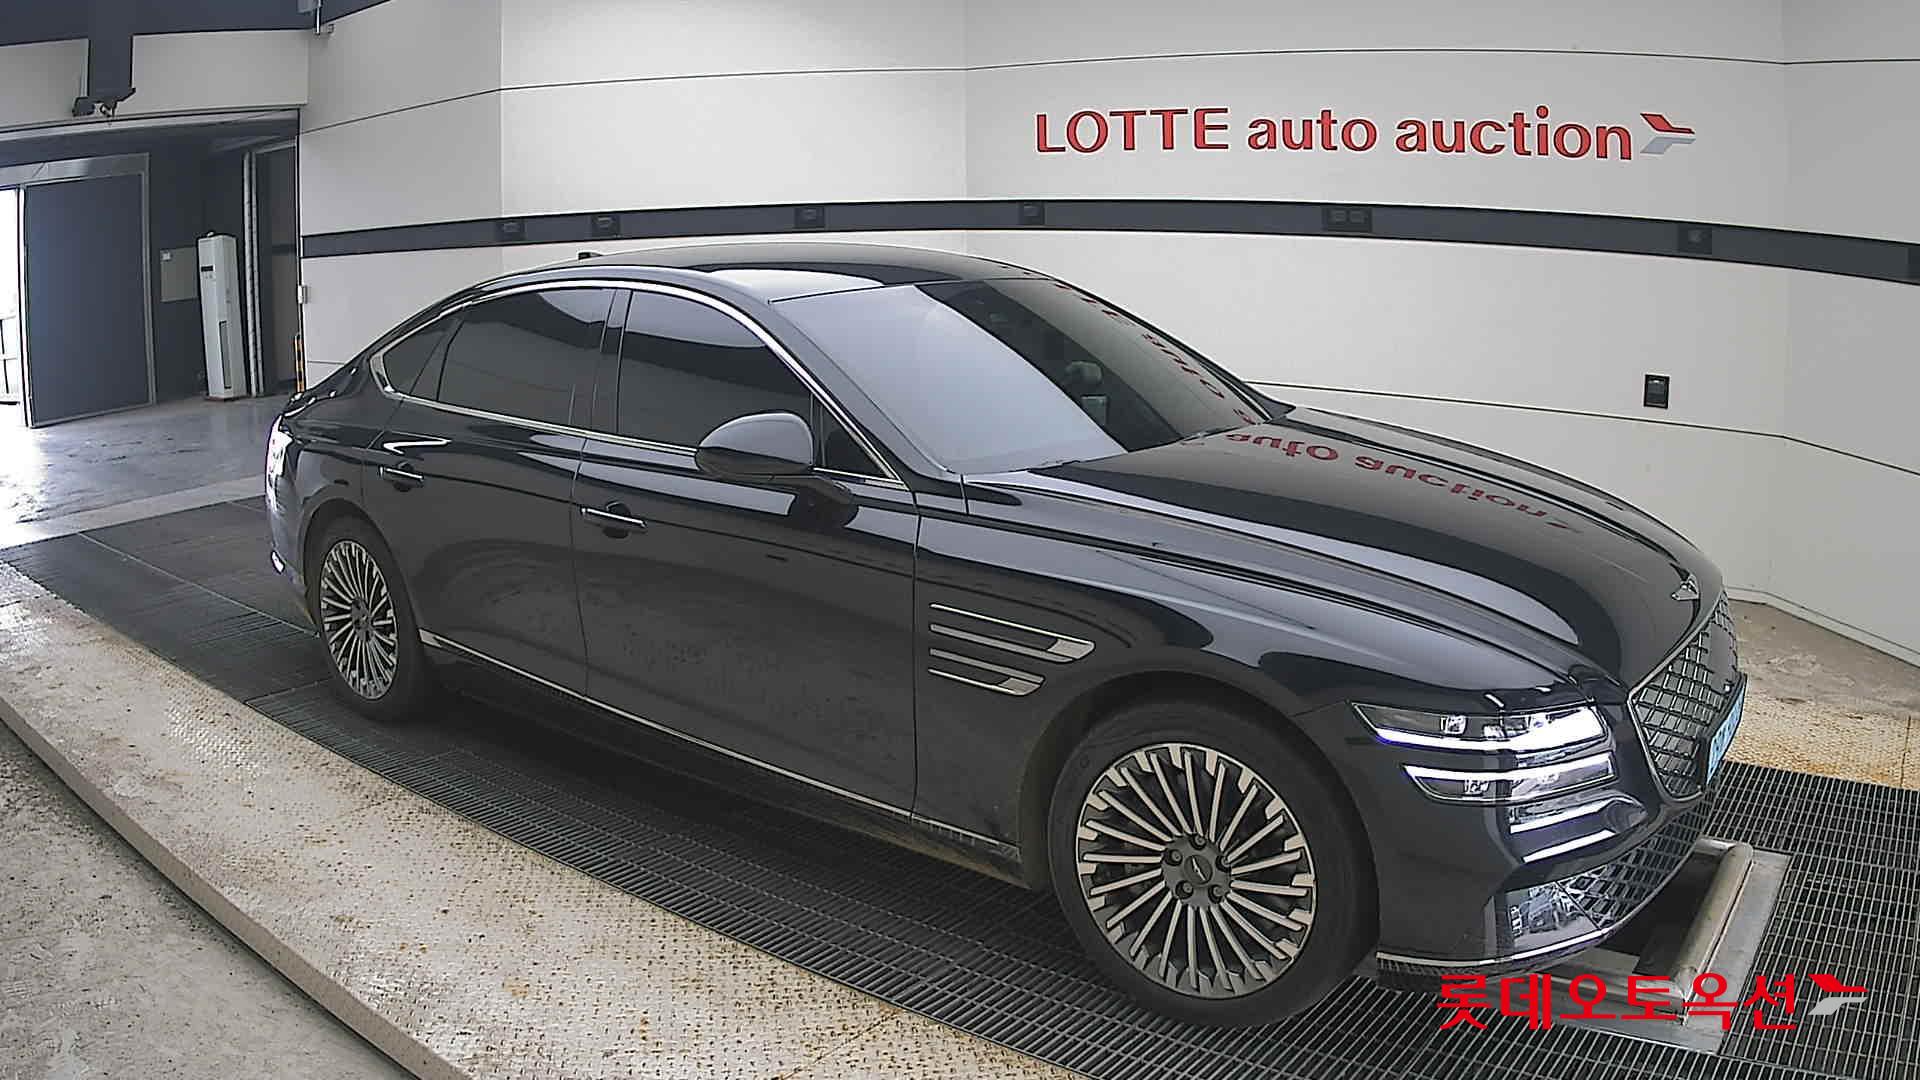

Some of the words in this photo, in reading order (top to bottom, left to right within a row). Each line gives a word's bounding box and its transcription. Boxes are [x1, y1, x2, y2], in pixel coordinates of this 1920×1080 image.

[1036, 108, 1230, 153] LOTTE
[1247, 108, 1378, 152] auto
[1395, 104, 1633, 160] auction
